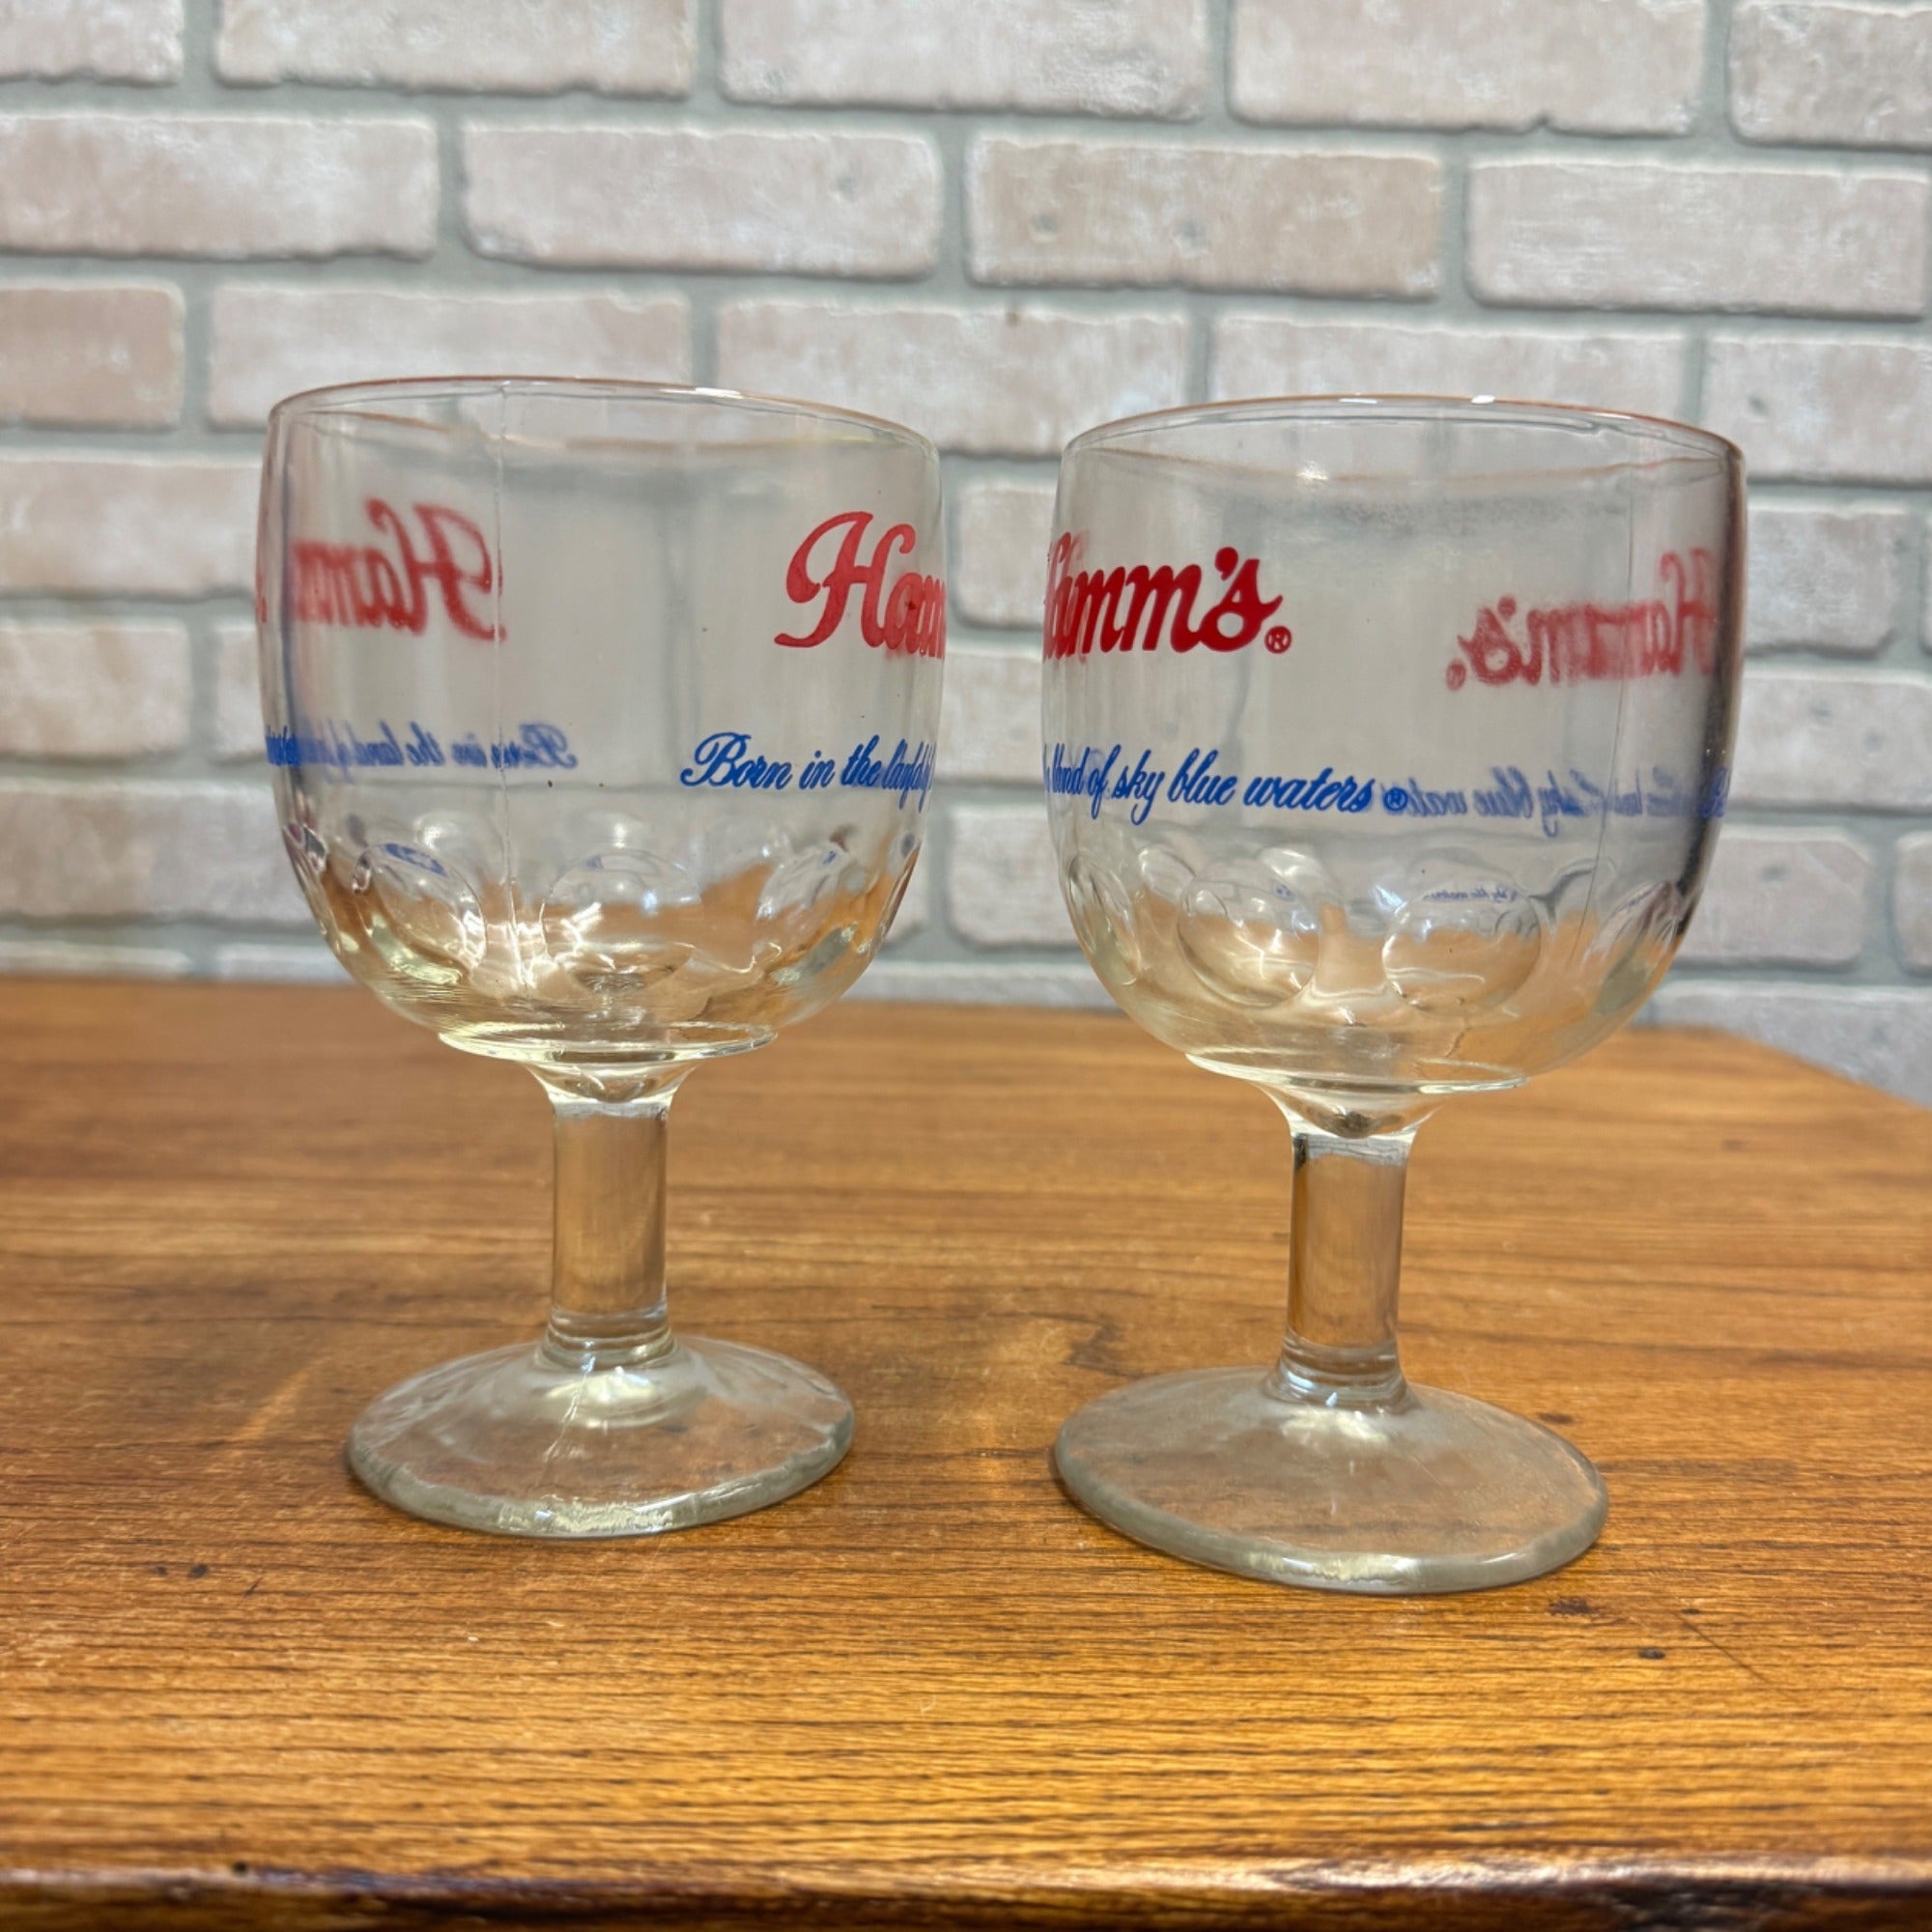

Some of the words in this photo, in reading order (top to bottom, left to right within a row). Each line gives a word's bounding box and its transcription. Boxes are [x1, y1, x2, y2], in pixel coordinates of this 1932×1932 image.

[679, 731, 793, 790] Born
[799, 751, 836, 789] in
[840, 734, 882, 787] the
[1088, 744, 1122, 820] of
[1111, 749, 1165, 826] sky
[1167, 748, 1238, 806] blue
